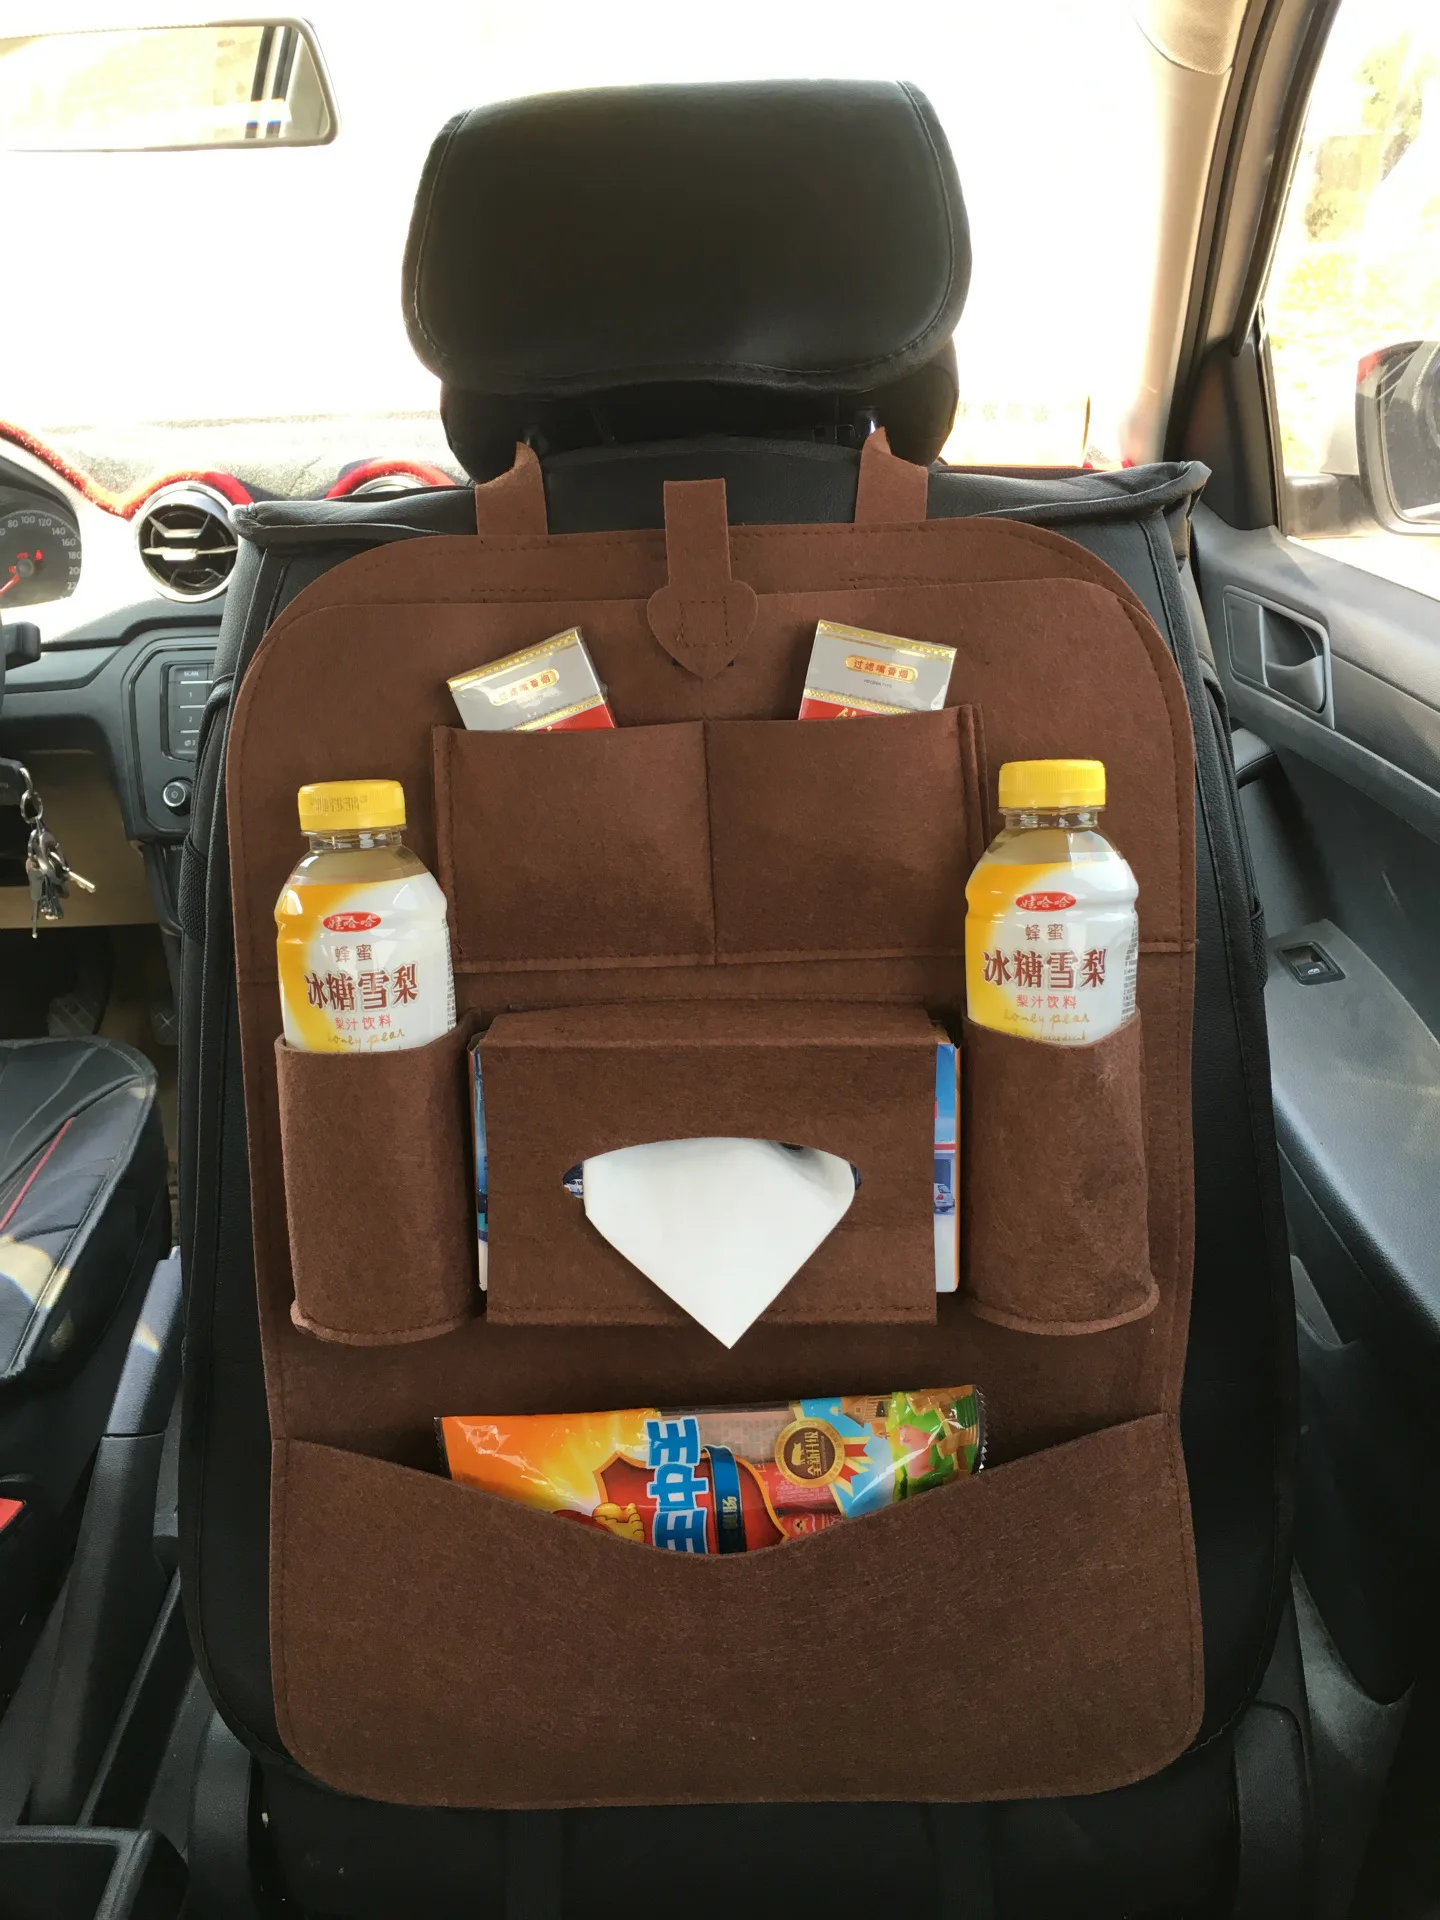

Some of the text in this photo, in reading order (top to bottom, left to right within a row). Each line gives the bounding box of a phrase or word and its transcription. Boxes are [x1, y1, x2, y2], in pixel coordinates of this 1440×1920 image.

[7, 520, 19, 528] 80
[21, 516, 36, 524] 100
[38, 518, 52, 527] 120
[51, 527, 66, 535] 140
[61, 538, 76, 547] 160
[853, 659, 909, 679] 过滤嘴香烟
[1020, 896, 1070, 909] 娃哈哈
[327, 914, 376, 930] 娃哈哈
[1025, 923, 1064, 941] 蜂蜜
[335, 944, 373, 962] 蜂蜜
[983, 949, 1107, 988] 冰糖雪梨
[303, 963, 419, 1011] 冰糖雪梨
[1016, 994, 1077, 1009] 梨汁饮料
[334, 1013, 392, 1031] 梨汁饮料
